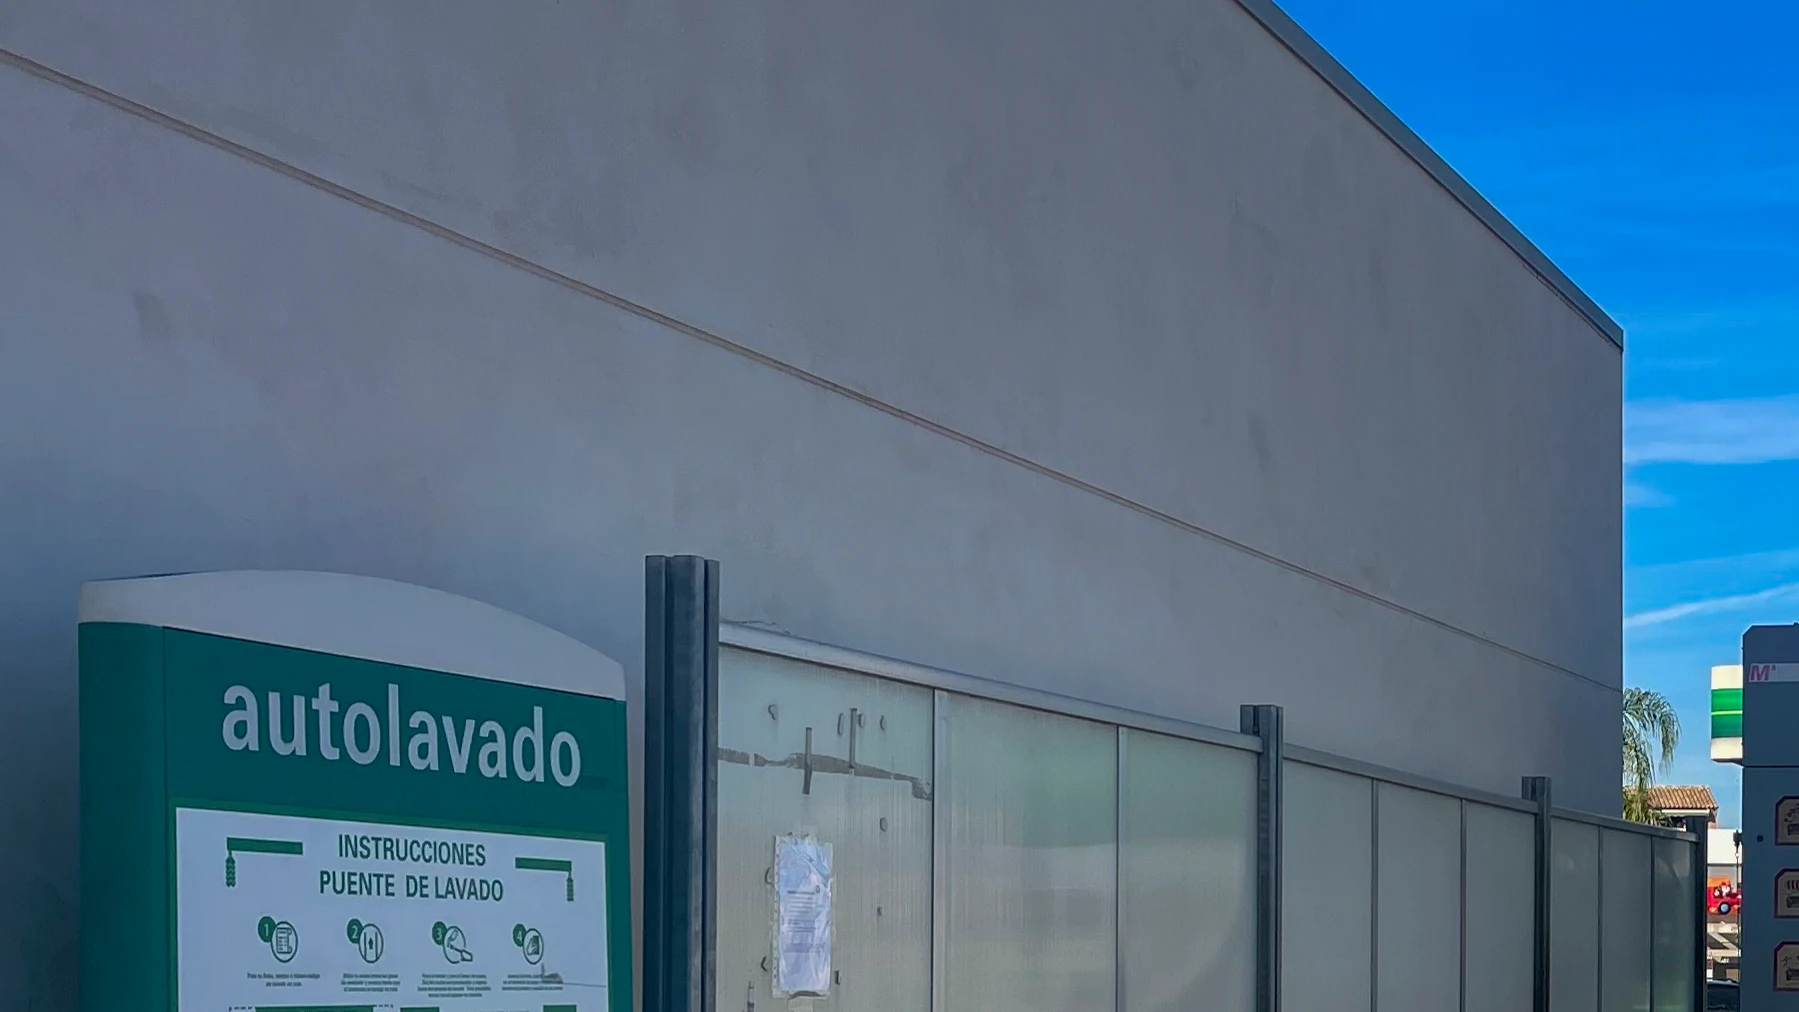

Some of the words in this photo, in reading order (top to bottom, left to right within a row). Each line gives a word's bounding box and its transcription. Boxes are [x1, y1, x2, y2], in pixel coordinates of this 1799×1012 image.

[222, 682, 582, 787] autolavado
[338, 834, 487, 867] INSTRUCCIONES
[319, 870, 396, 898] PUENTE
[406, 875, 431, 898] DE
[434, 876, 504, 901] LAVADO
[264, 923, 270, 937] 1
[352, 925, 359, 939] 2
[436, 928, 442, 941] 3
[516, 931, 523, 942] 4
